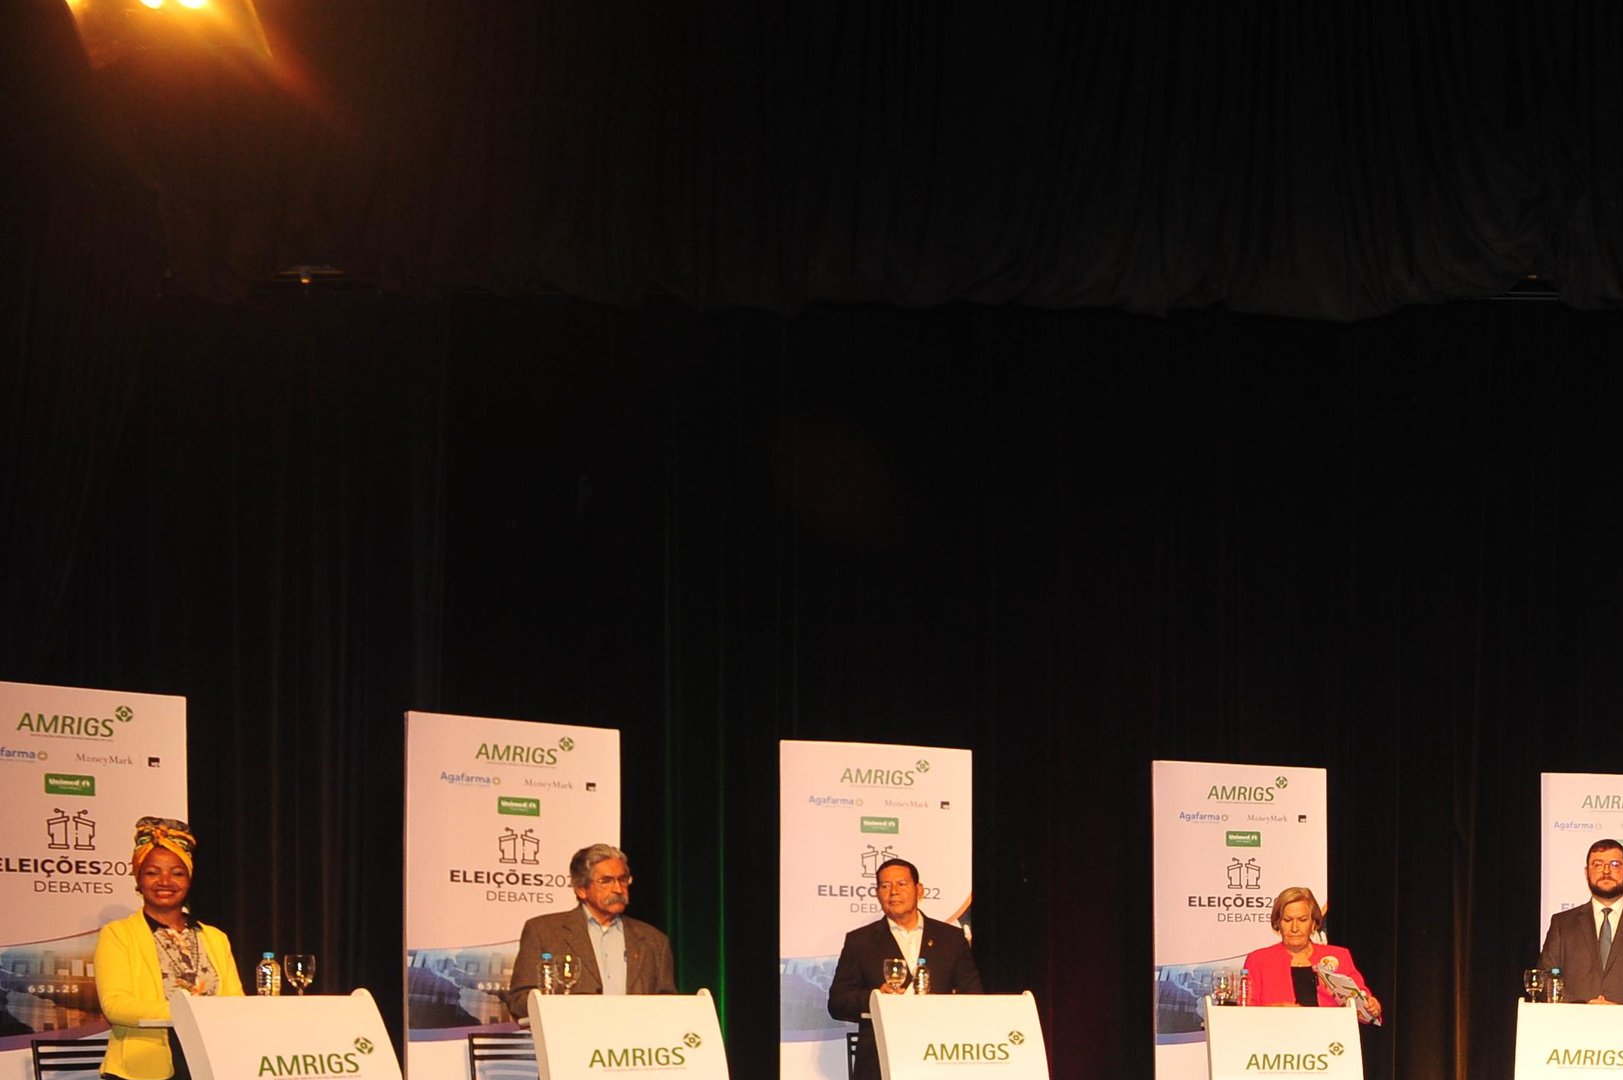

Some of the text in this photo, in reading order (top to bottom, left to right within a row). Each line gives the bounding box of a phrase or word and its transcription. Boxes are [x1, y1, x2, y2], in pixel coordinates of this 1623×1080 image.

[17, 713, 114, 737] AMRIGS
[475, 743, 558, 765] AMRIGS
[440, 772, 491, 784] Agafarma
[840, 768, 914, 786] AMRIGS
[809, 795, 854, 806] Agafarma
[1208, 786, 1274, 801] AMRIGS
[1180, 812, 1220, 822] Agafarma
[1554, 821, 1593, 830] Agafarma
[34, 880, 113, 894] DEBATES
[486, 891, 554, 903] DEBATES
[28, 985, 79, 993] 653.25
[589, 1047, 685, 1068] AMRIGS
[923, 1043, 1009, 1061] AMRIGS
[258, 1052, 359, 1077] AMRIGS
[1246, 1054, 1328, 1070] AMRIGS
